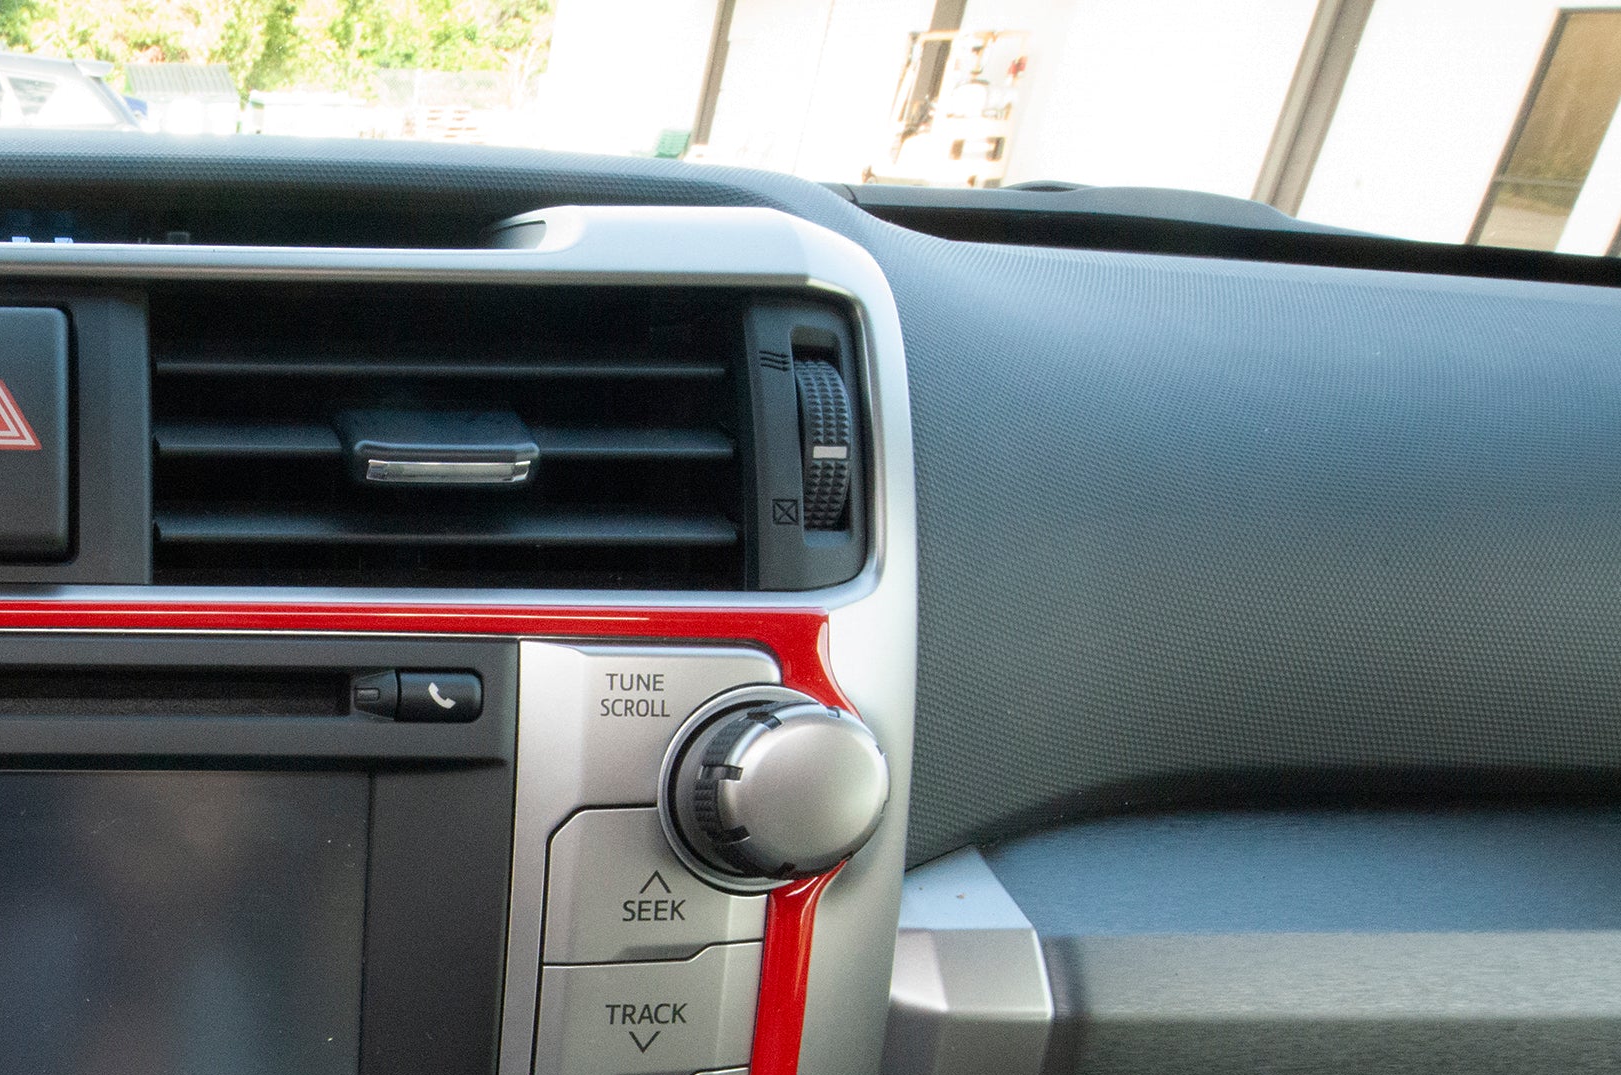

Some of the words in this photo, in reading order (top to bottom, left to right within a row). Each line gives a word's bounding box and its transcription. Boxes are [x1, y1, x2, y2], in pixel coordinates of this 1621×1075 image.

[606, 673, 665, 692] TUNE
[600, 698, 671, 718] SCROLL
[622, 899, 686, 922] SEEK
[606, 1003, 688, 1026] TRACK
